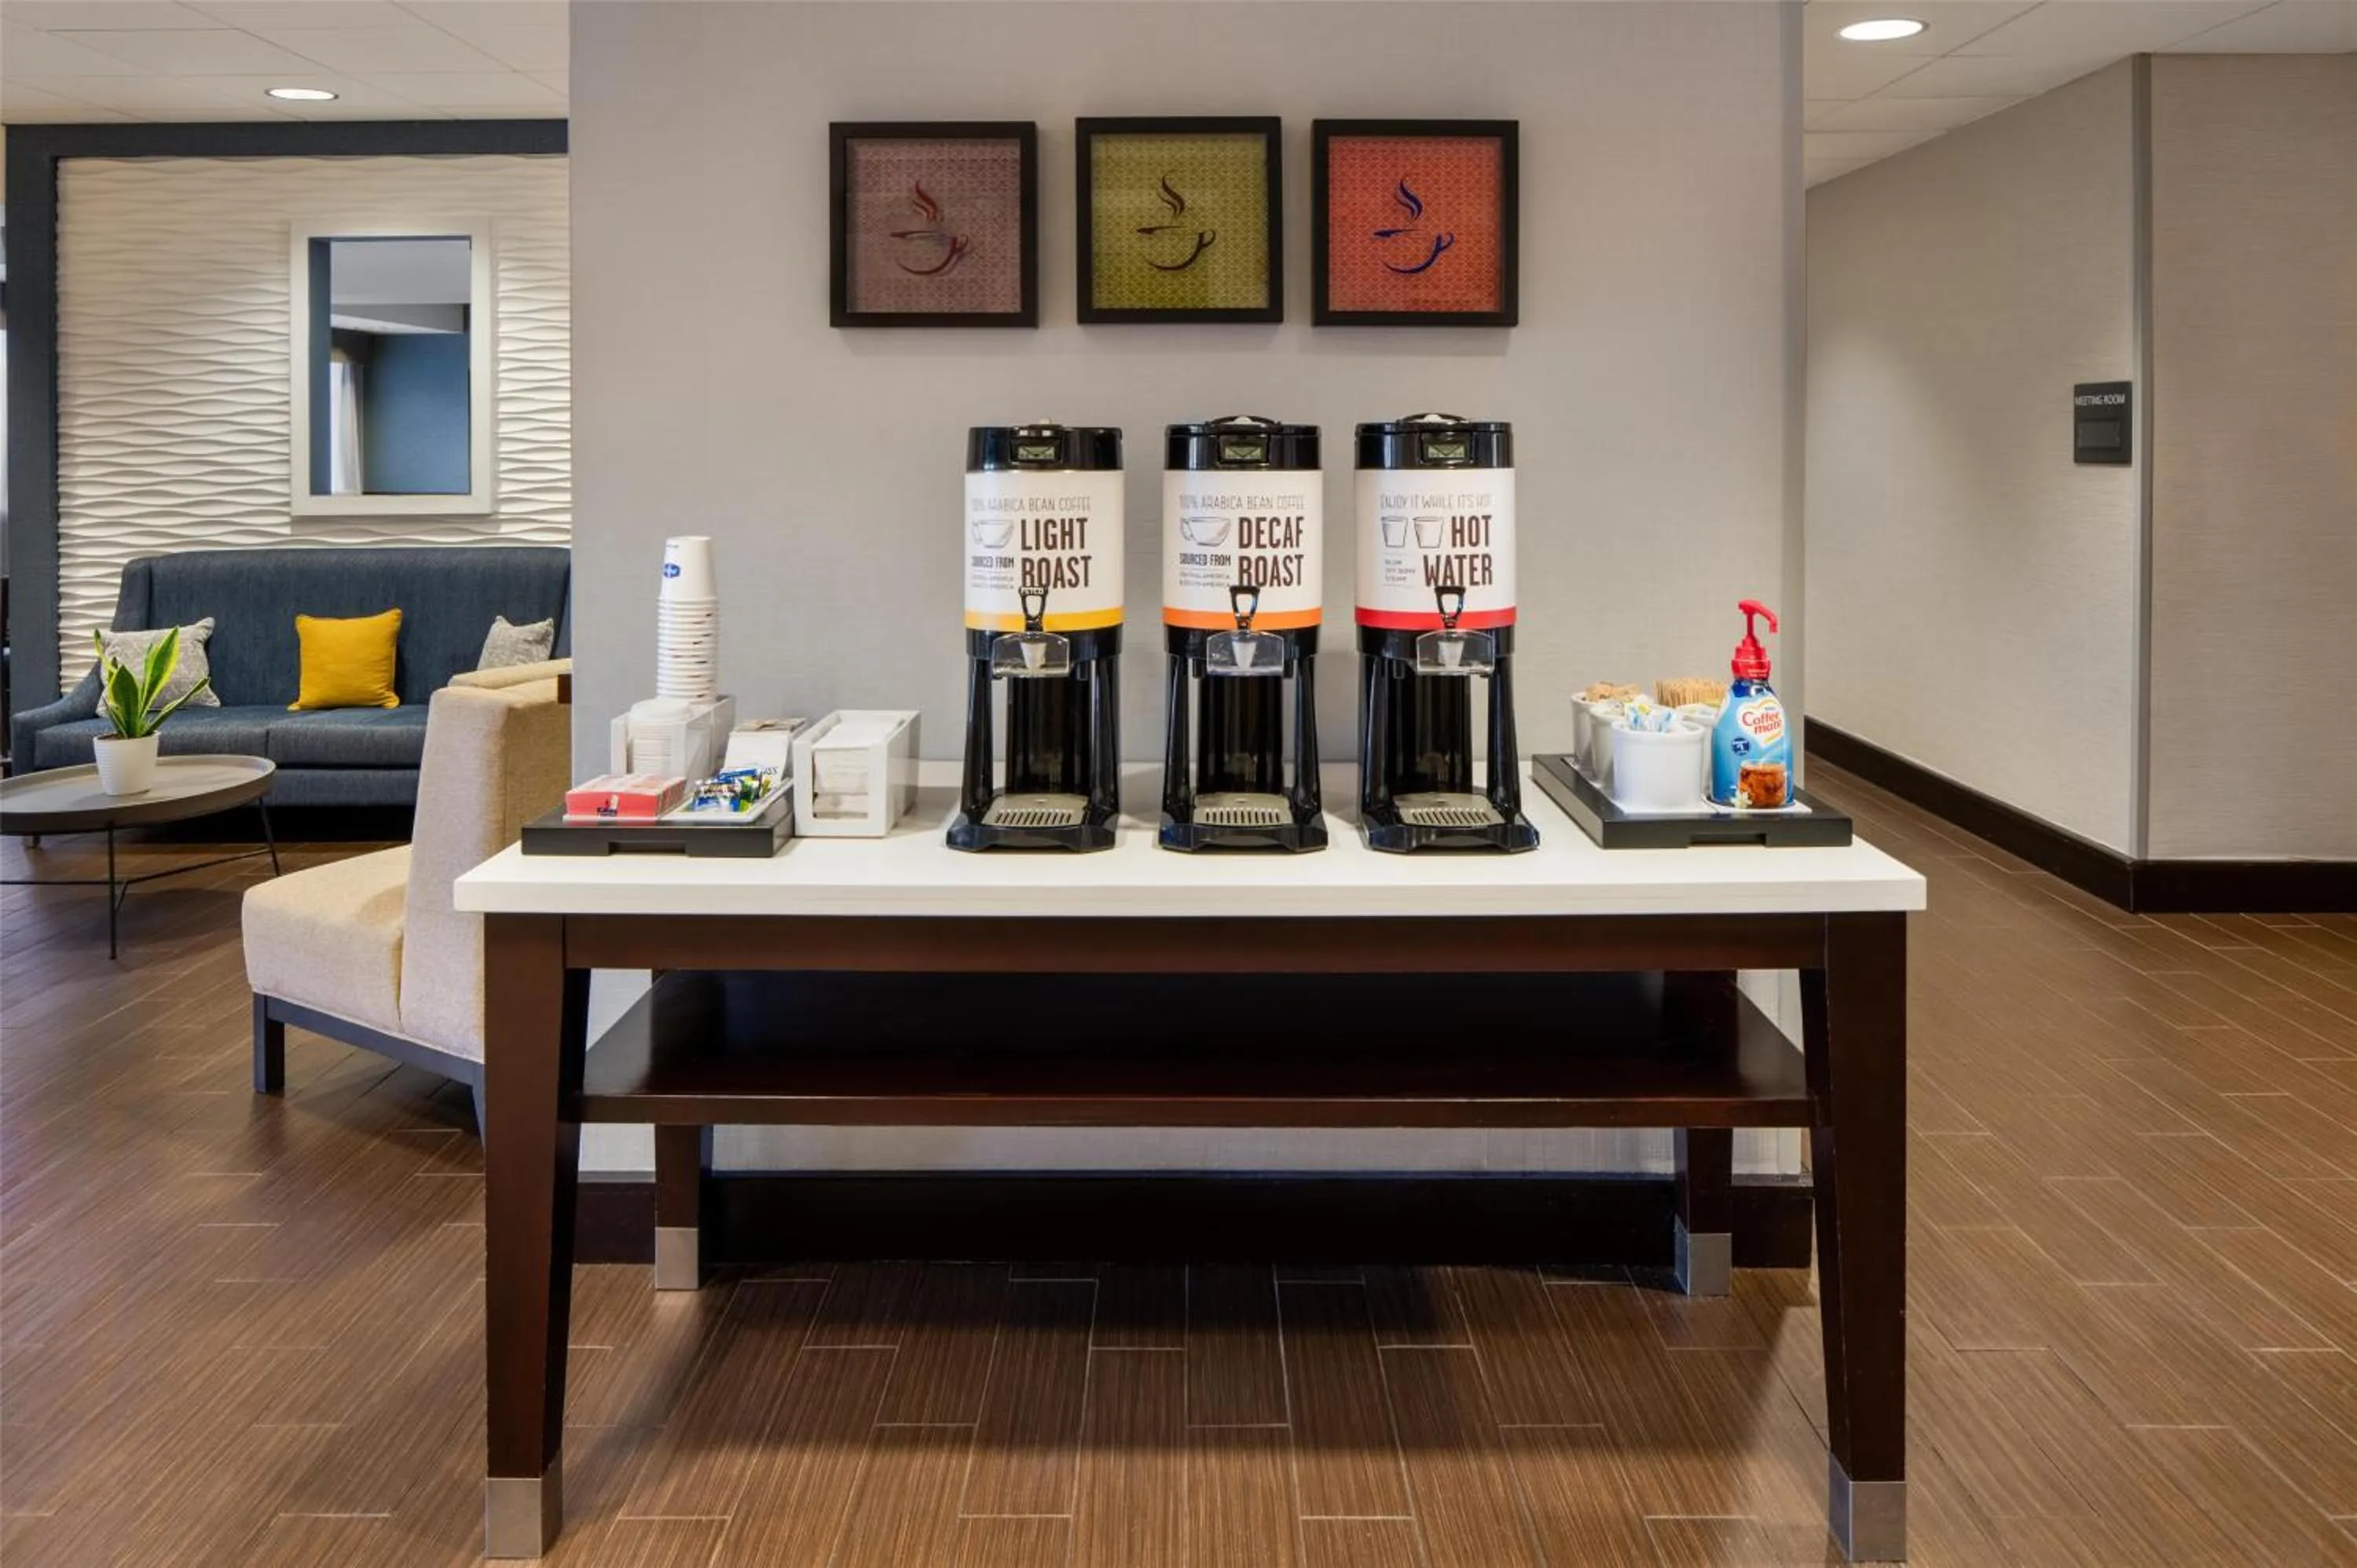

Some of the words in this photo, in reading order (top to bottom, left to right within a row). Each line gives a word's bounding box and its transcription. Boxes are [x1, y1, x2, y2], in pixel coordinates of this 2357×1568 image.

[2103, 394, 2124, 405] ROOM
[1028, 496, 1055, 511] BEAN
[1201, 495, 1243, 510] ARABICA
[1247, 496, 1273, 510] BEAN
[1380, 494, 1407, 510] ENJOY
[1021, 517, 1088, 551] LIGHT
[1237, 516, 1304, 549] DECAF
[1451, 515, 1492, 548] HOT
[995, 556, 1014, 568] FROM
[1179, 552, 1208, 566] SOURCED
[1210, 553, 1231, 566] FROM
[1237, 554, 1304, 588] ROAST
[1423, 553, 1493, 588] WATER
[1021, 555, 1092, 588] ROAST
